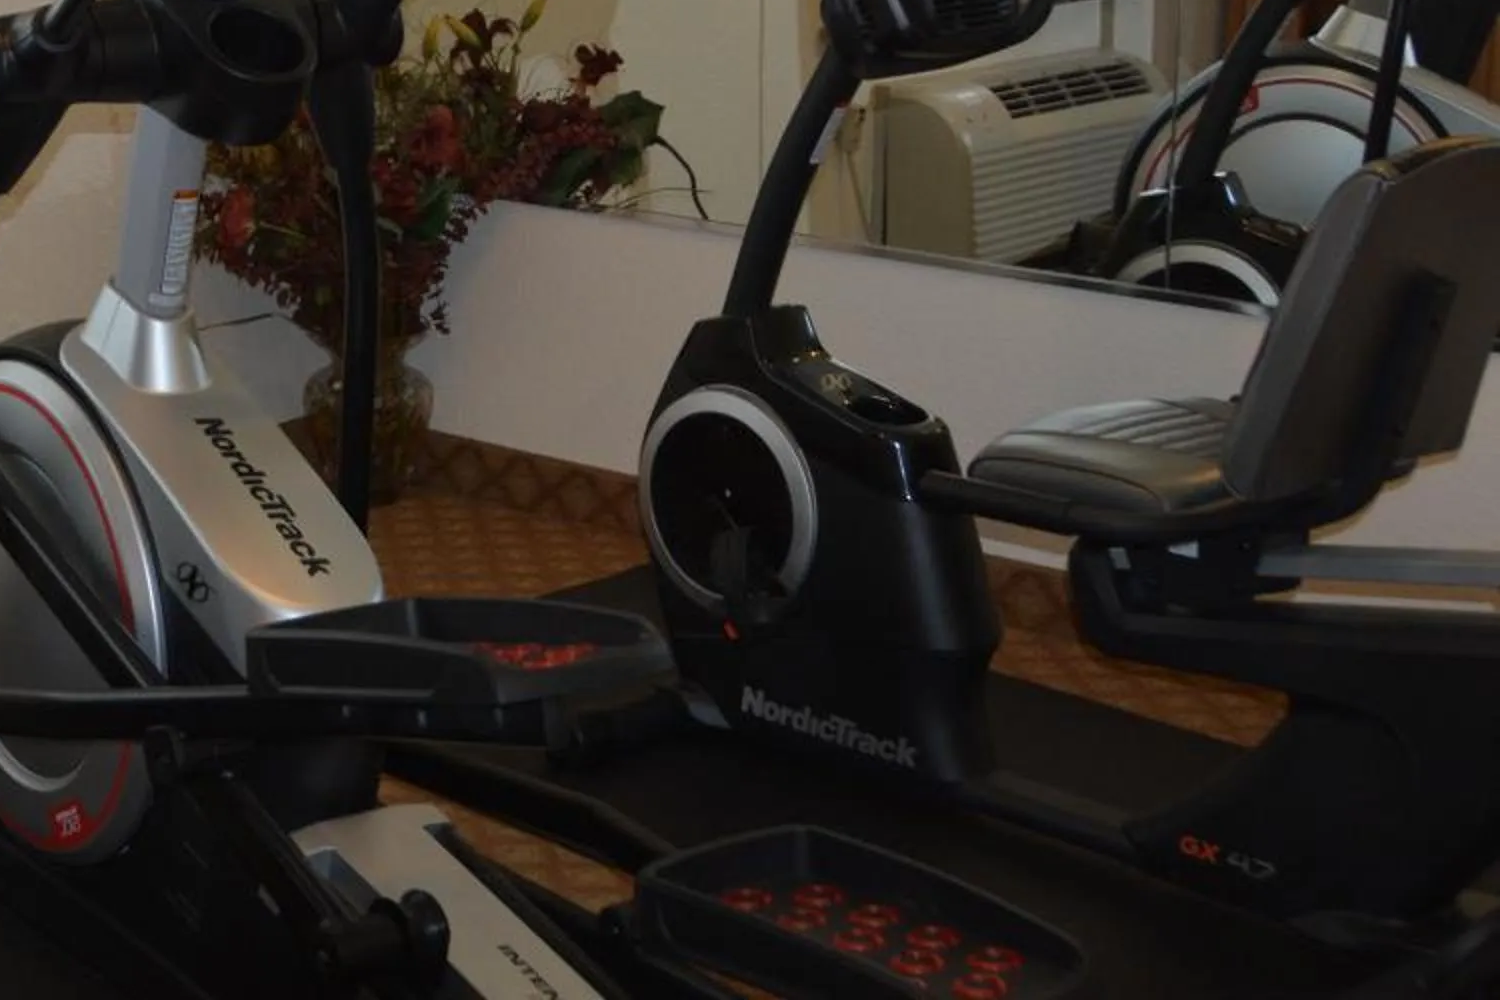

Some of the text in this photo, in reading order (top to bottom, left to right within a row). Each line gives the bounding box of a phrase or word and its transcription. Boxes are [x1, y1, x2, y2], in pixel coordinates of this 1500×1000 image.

[193, 416, 332, 578] NordicTrack
[741, 685, 918, 768] NordicTrack
[1180, 835, 1220, 865] GX
